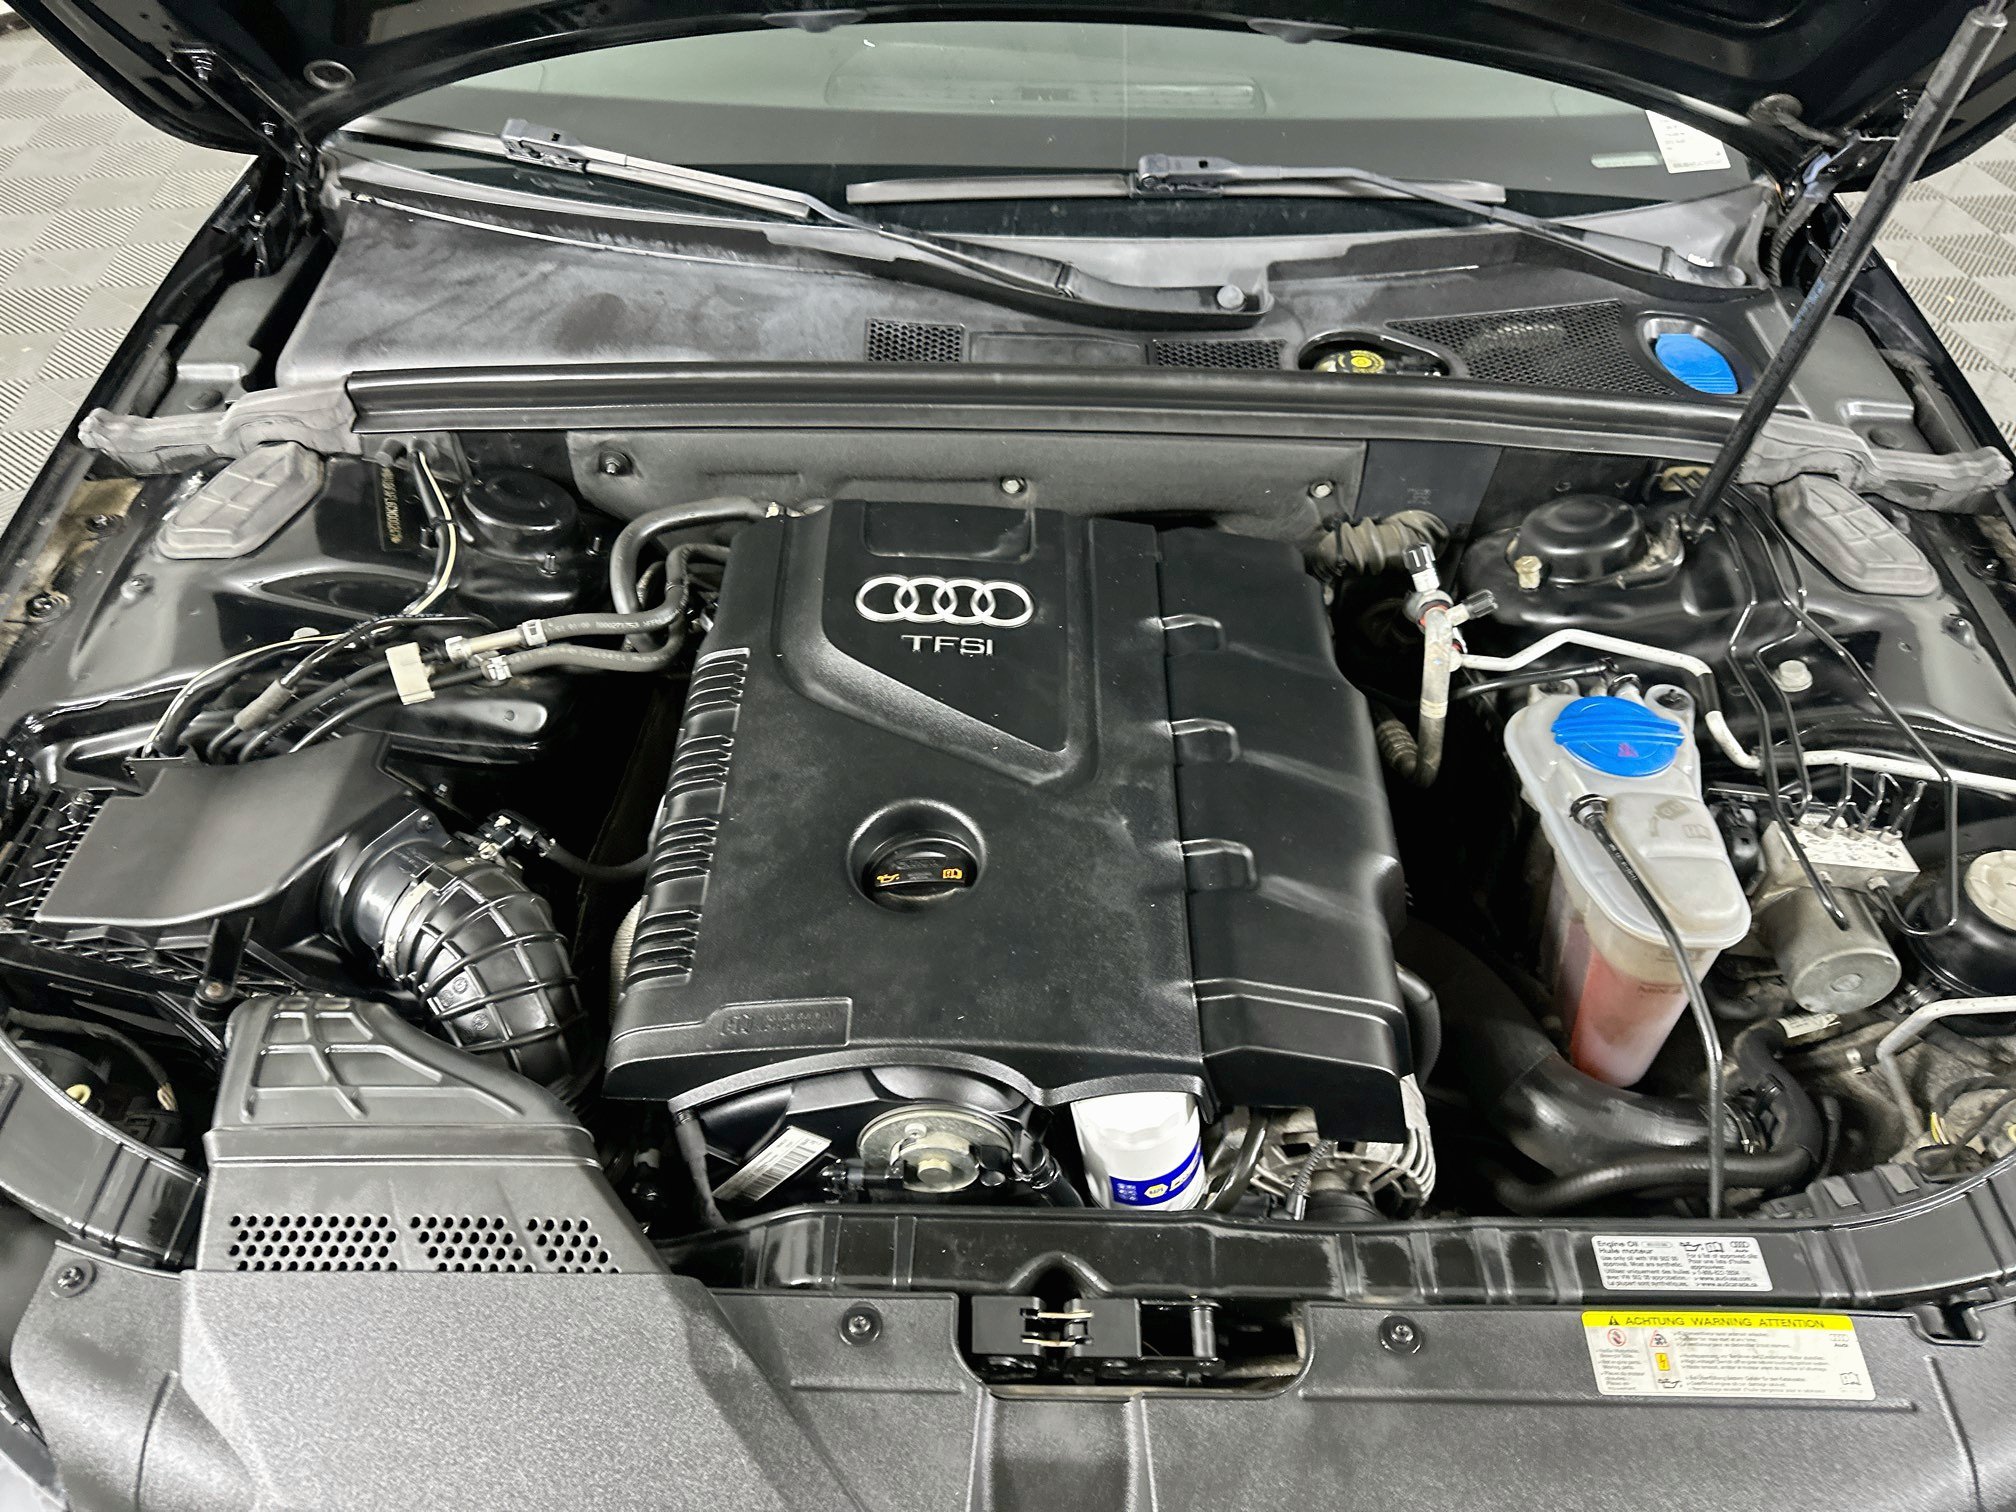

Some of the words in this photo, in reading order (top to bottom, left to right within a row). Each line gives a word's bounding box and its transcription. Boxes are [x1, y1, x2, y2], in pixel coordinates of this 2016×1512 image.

[900, 634, 994, 657] TFSI
[1597, 1240, 1625, 1250] Engine
[1625, 1316, 1685, 1326] ACHTUNG
[1690, 1317, 1753, 1327] WARNING
[1759, 1317, 1825, 1328] ATTENTION
